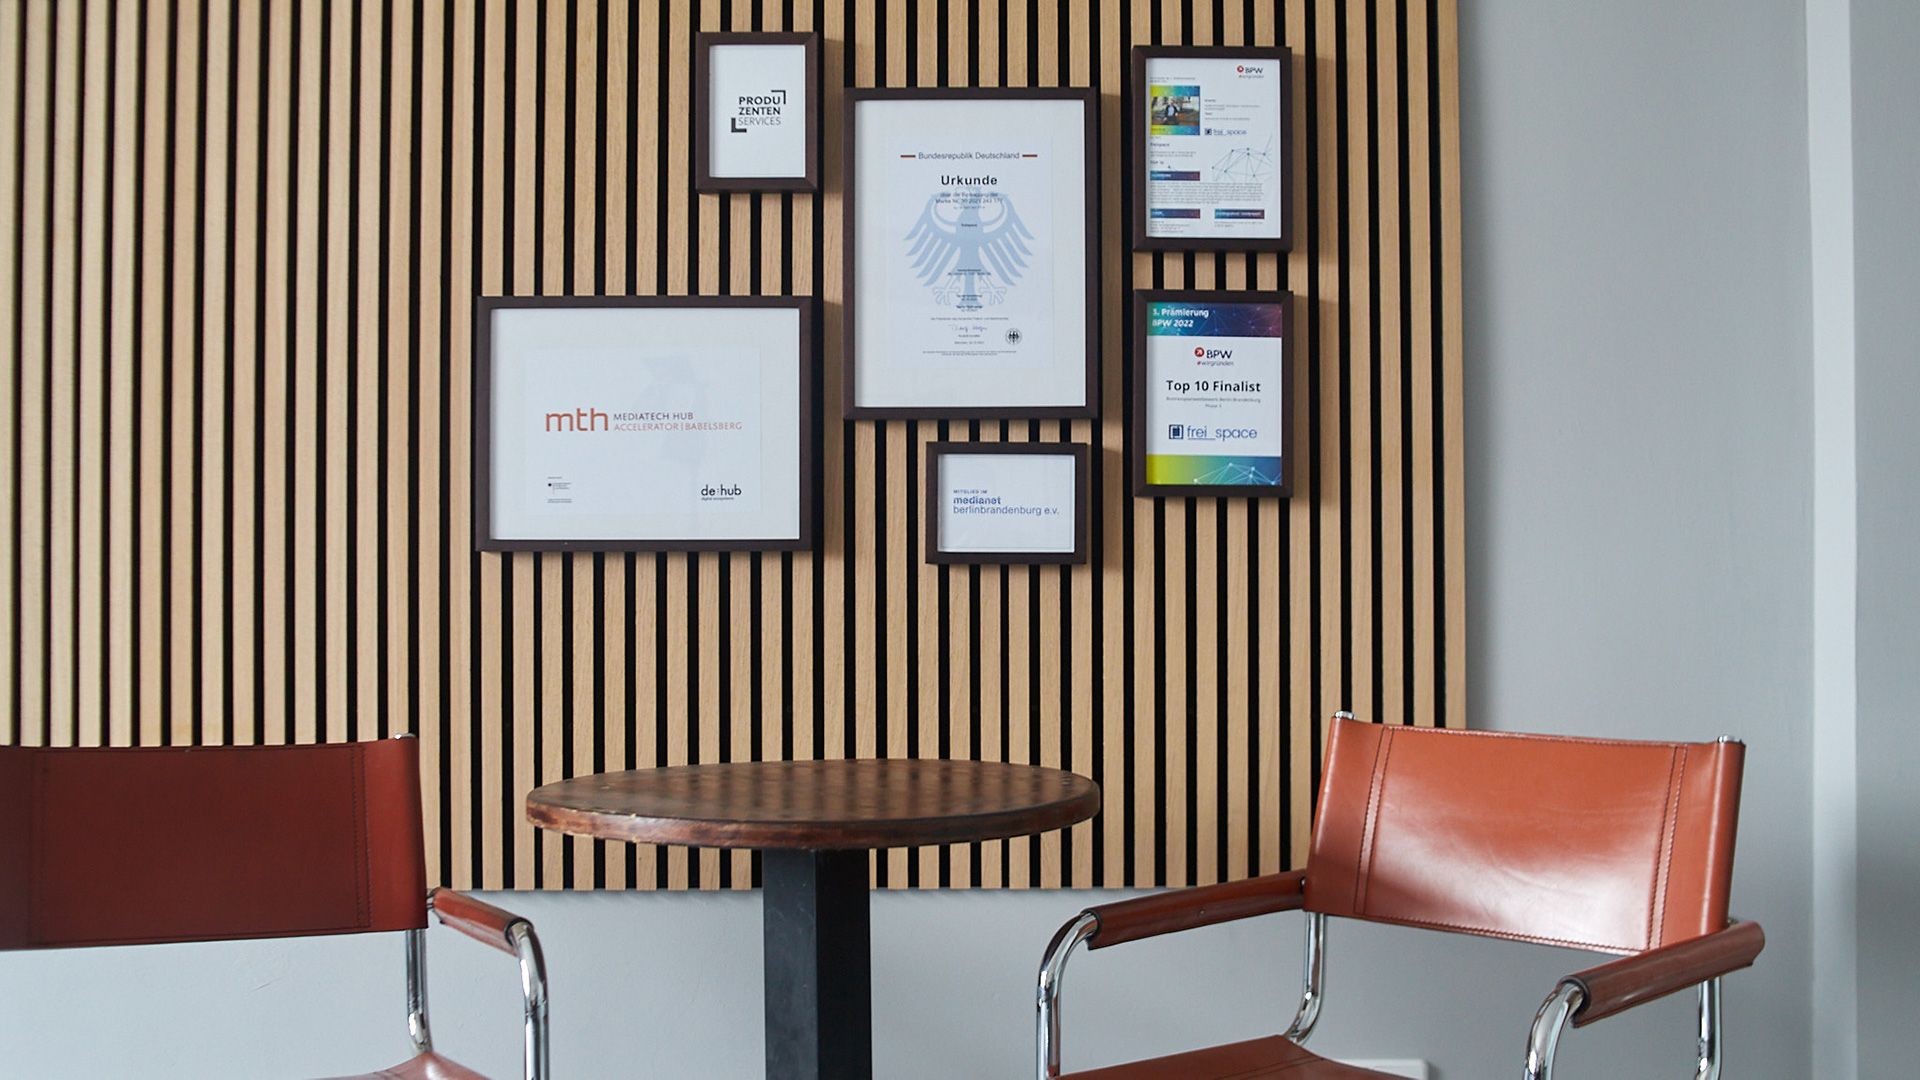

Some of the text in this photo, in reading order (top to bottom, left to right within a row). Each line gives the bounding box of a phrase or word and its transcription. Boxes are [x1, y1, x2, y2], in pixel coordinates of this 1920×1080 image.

[738, 96, 781, 105] PRODU
[738, 106, 781, 115] ZENTEN
[738, 117, 782, 126] SERVICES
[918, 152, 973, 160] Bundesrepublik
[941, 175, 998, 185] Urkunde
[1161, 307, 1210, 319] Prämierung
[1152, 319, 1194, 328] BPW 2022
[1206, 349, 1233, 359] BPW
[1166, 380, 1261, 394] Top 10 Finalist
[545, 408, 608, 432] mth
[613, 412, 695, 421] MEDIATECH HUB
[953, 495, 1002, 505] medianet
[953, 505, 1042, 516] berlinbrandenburg
